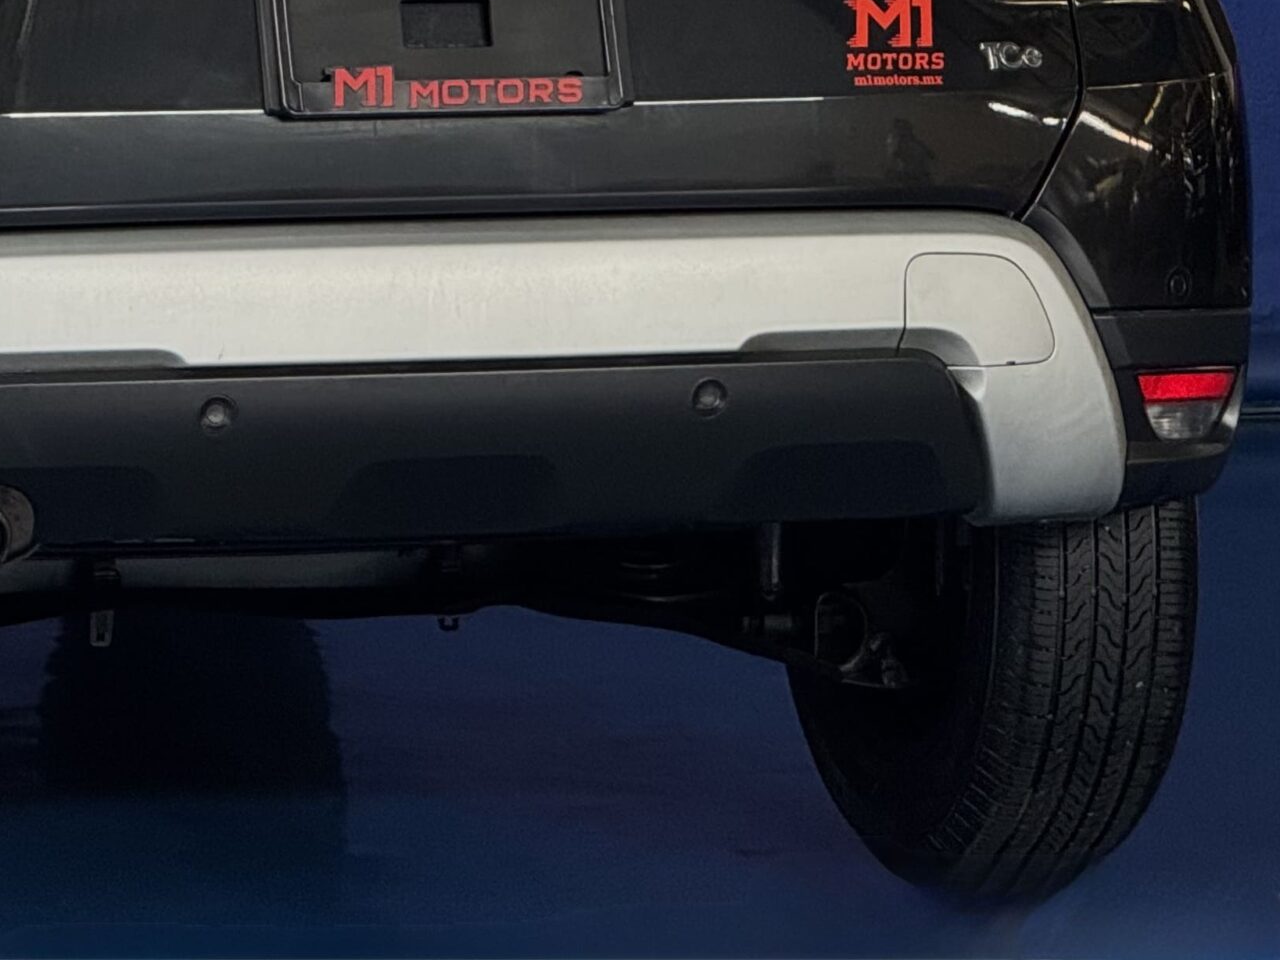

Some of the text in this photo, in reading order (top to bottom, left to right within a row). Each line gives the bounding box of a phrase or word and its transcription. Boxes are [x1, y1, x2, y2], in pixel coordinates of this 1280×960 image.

[846, 52, 945, 71] MOTORS
[979, 42, 1043, 70] TCe
[333, 66, 583, 108] M1 MOTORS
[854, 74, 943, 86] m1motors.mx
